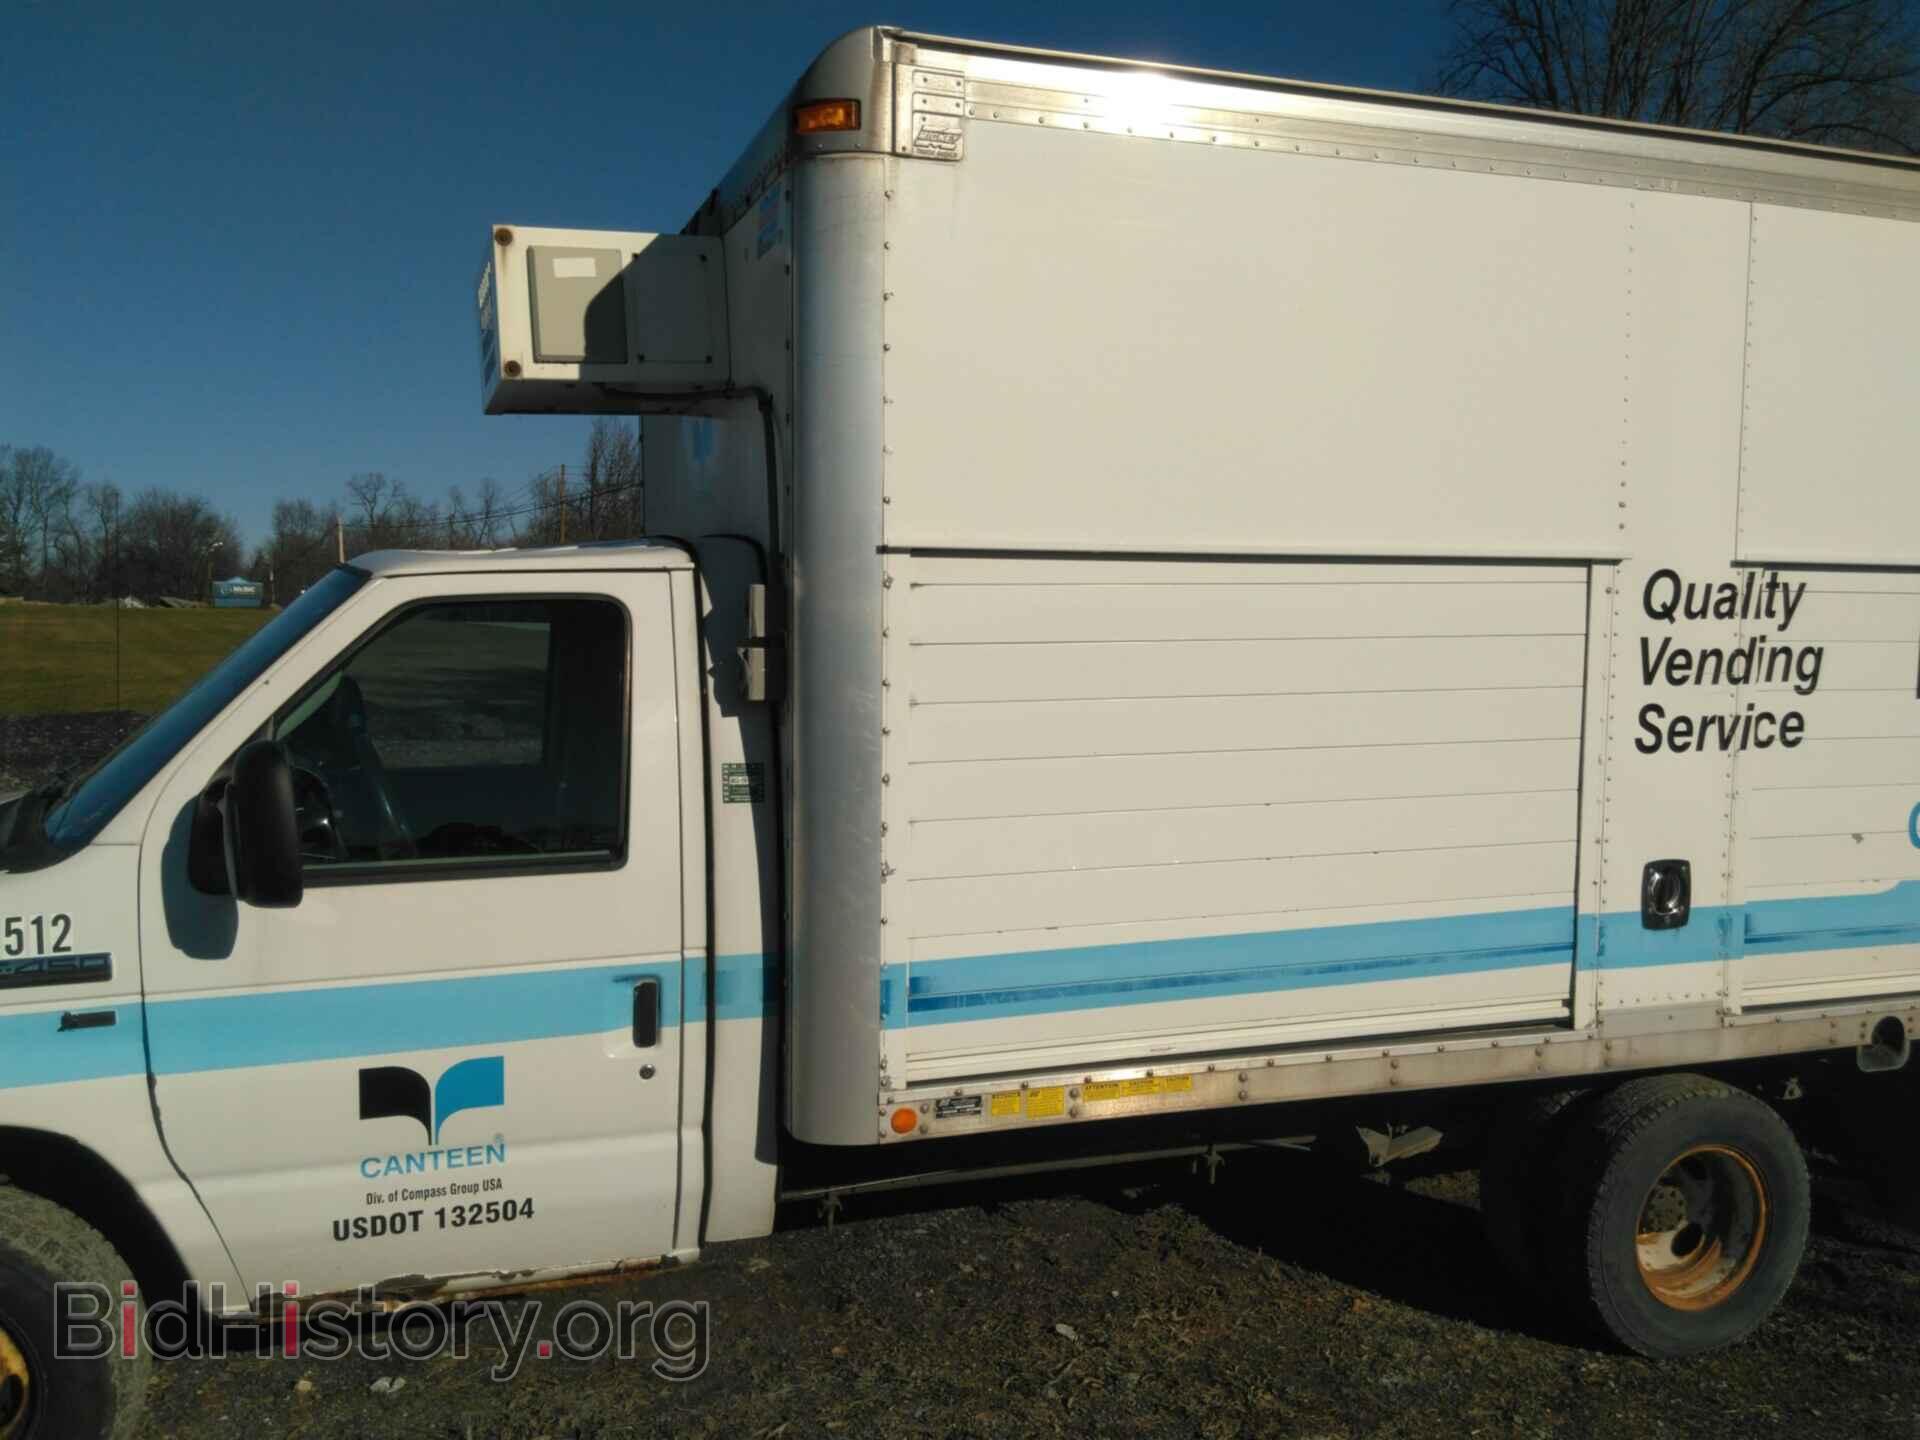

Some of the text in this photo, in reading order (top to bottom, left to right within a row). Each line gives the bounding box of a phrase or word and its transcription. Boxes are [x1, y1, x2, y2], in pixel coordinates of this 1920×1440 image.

[1642, 568, 1807, 631] Quality
[1640, 635, 1824, 695] Vending
[1635, 703, 1805, 754] Service
[5, 914, 72, 955] 512
[360, 1144, 506, 1178] CANTEEN
[366, 1178, 502, 1205] Div. of Compass Group USA
[333, 1198, 535, 1242] USDOT 132504
